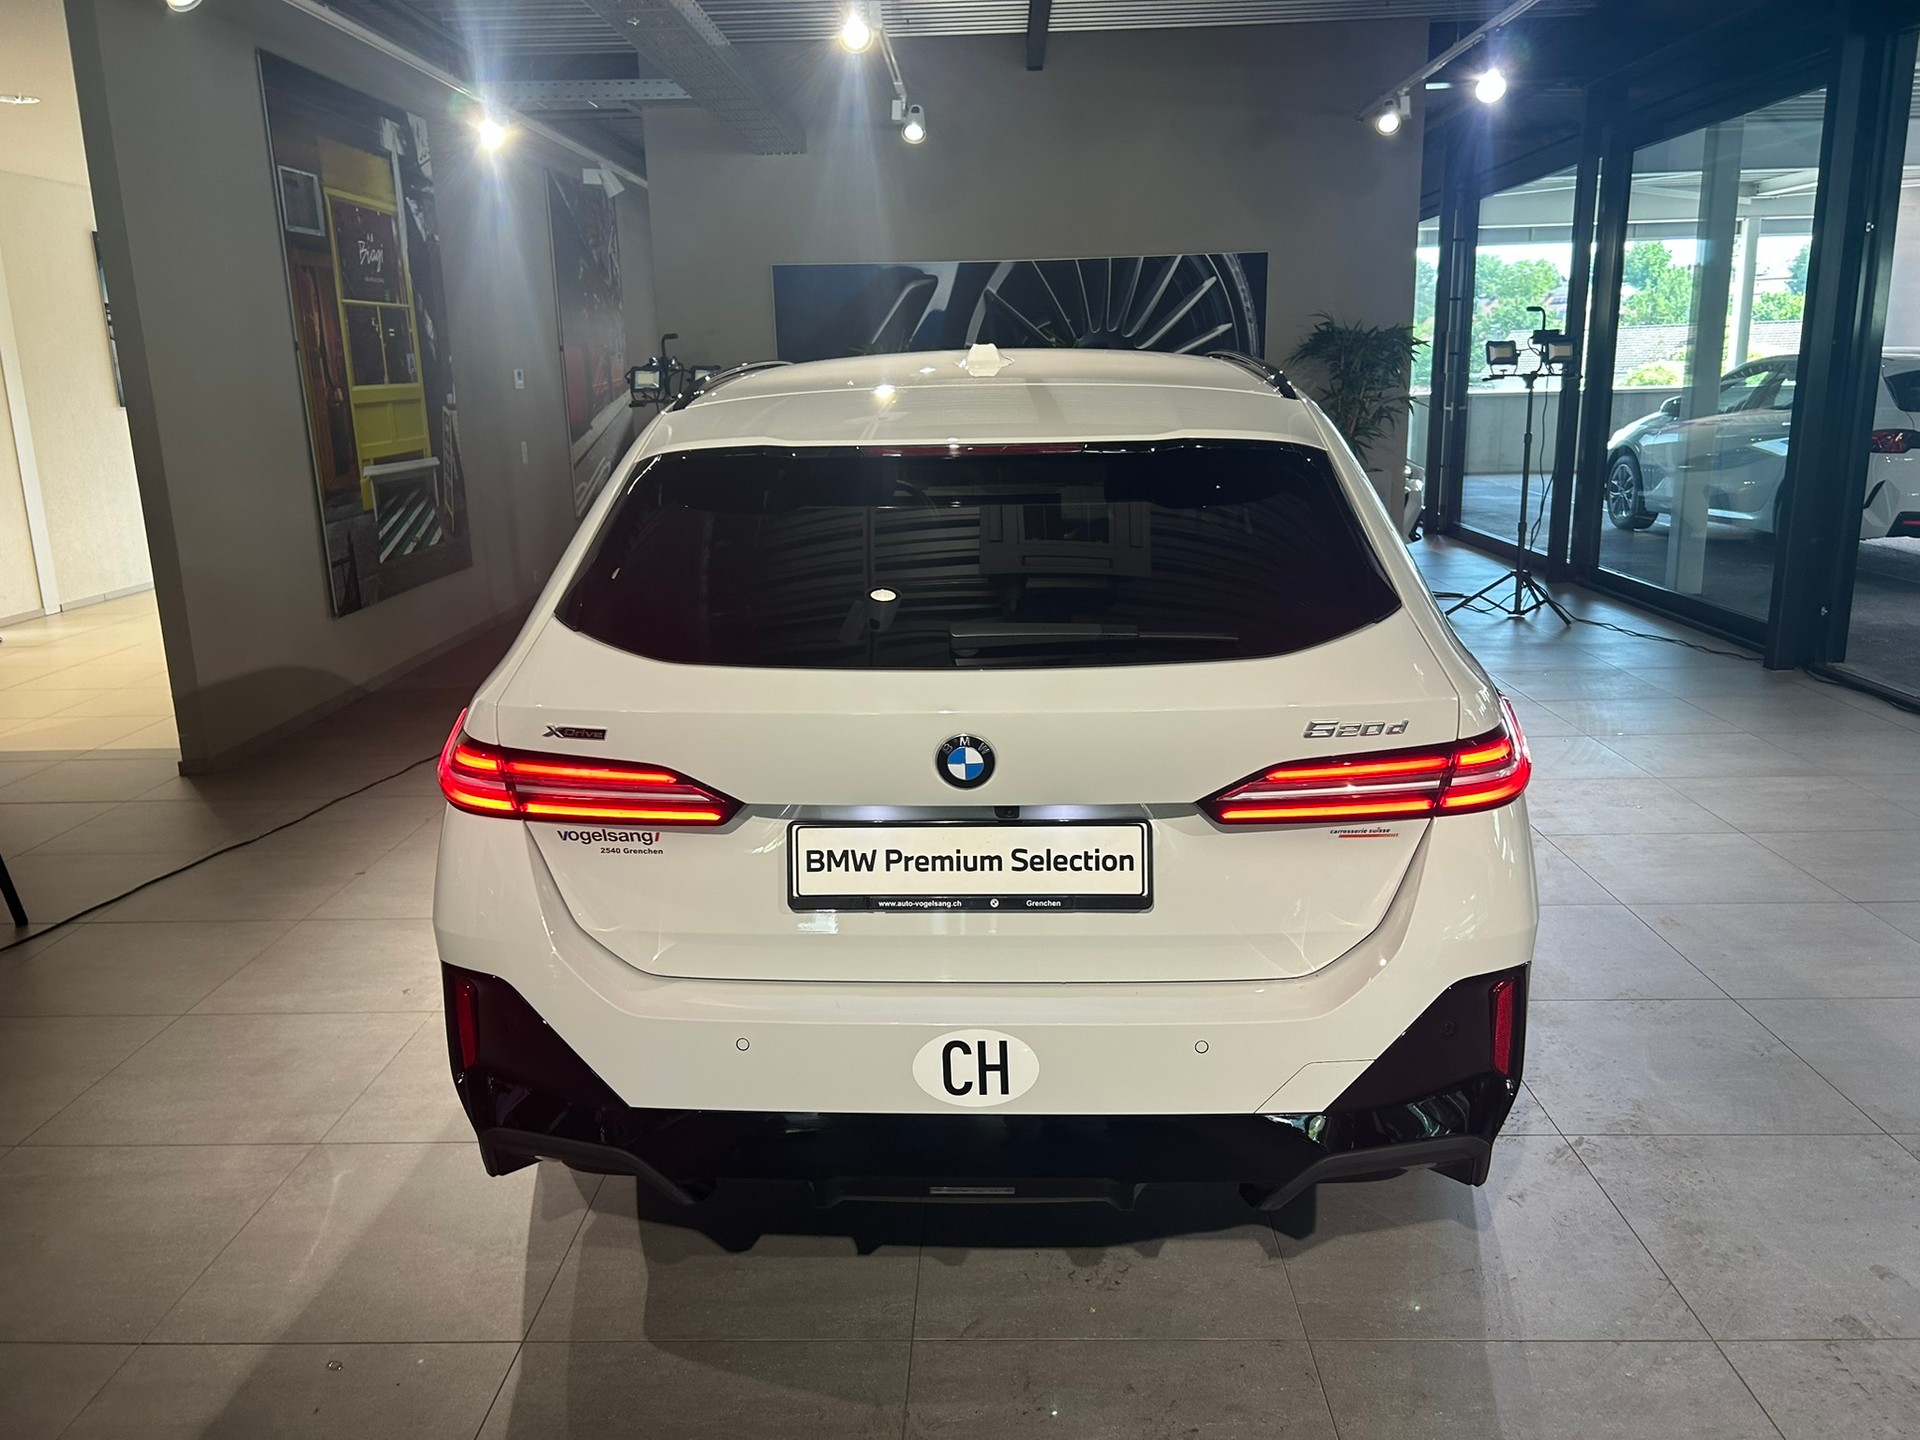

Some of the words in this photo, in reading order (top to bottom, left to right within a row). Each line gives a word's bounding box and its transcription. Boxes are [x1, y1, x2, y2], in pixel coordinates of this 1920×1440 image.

[943, 736, 990, 755] BMW
[623, 847, 664, 855] Grenchen
[805, 849, 877, 873] BMW
[885, 848, 1003, 872] Premium
[1010, 848, 1135, 872] Selection
[878, 899, 962, 908] www.auto-vogelsang.ch
[1026, 899, 1061, 908] Grenchen
[942, 1040, 1009, 1096] CH
